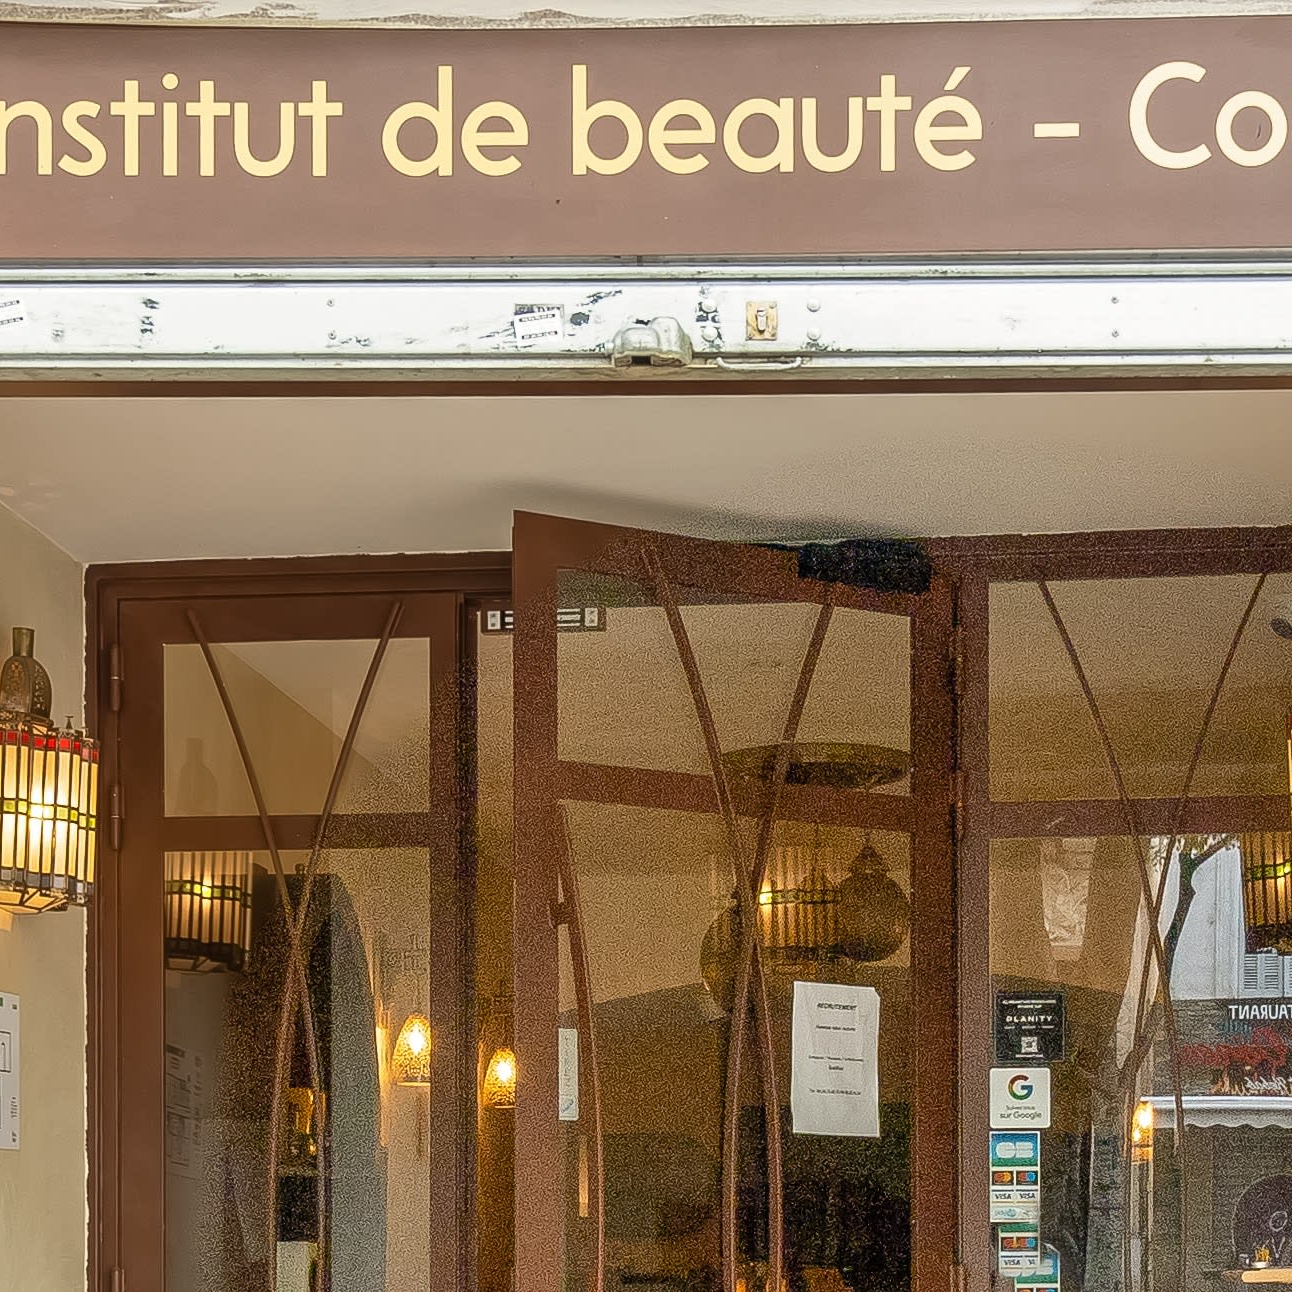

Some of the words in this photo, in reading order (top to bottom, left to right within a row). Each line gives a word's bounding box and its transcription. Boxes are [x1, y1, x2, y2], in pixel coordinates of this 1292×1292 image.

[382, 66, 528, 176] de
[573, 65, 982, 175] beauté
[1008, 1075, 1034, 1100] G
[1012, 1111, 1042, 1120] Google
